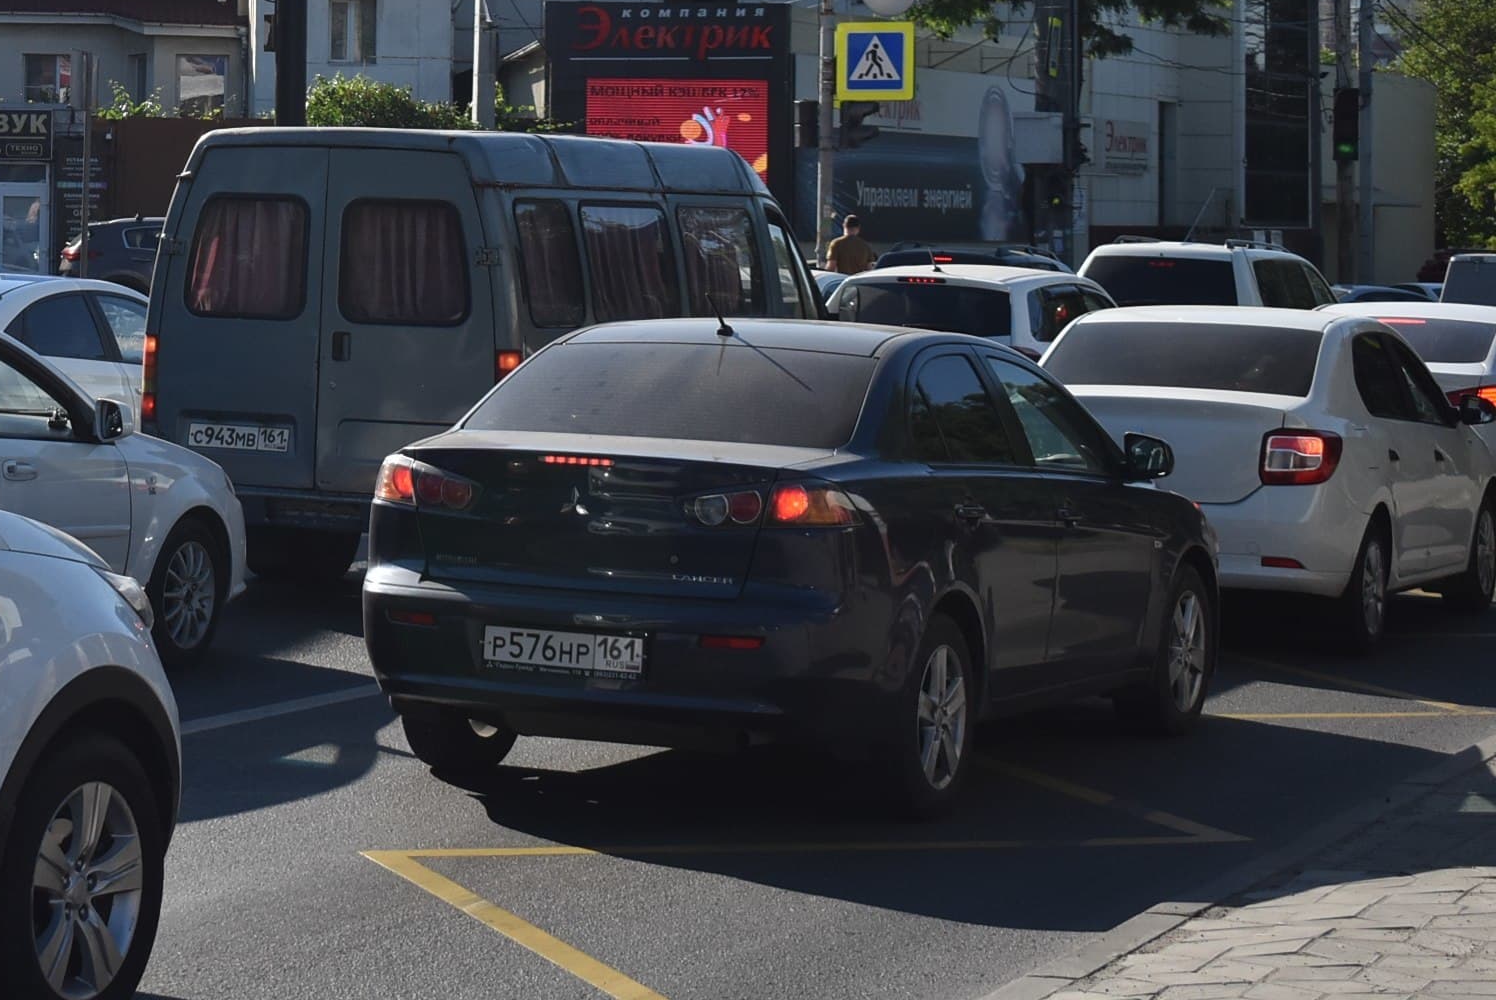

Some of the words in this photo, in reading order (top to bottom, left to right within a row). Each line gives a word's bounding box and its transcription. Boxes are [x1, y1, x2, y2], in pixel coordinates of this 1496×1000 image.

[620, 7, 766, 19] компания
[568, 4, 775, 62] Электрик
[855, 179, 919, 213] Управляем
[923, 184, 973, 215] энергией
[193, 426, 257, 448] С943МВ
[260, 429, 285, 445] 161
[492, 631, 591, 665] Р576НР
[597, 637, 637, 662] 161
[605, 660, 626, 670] RUS
